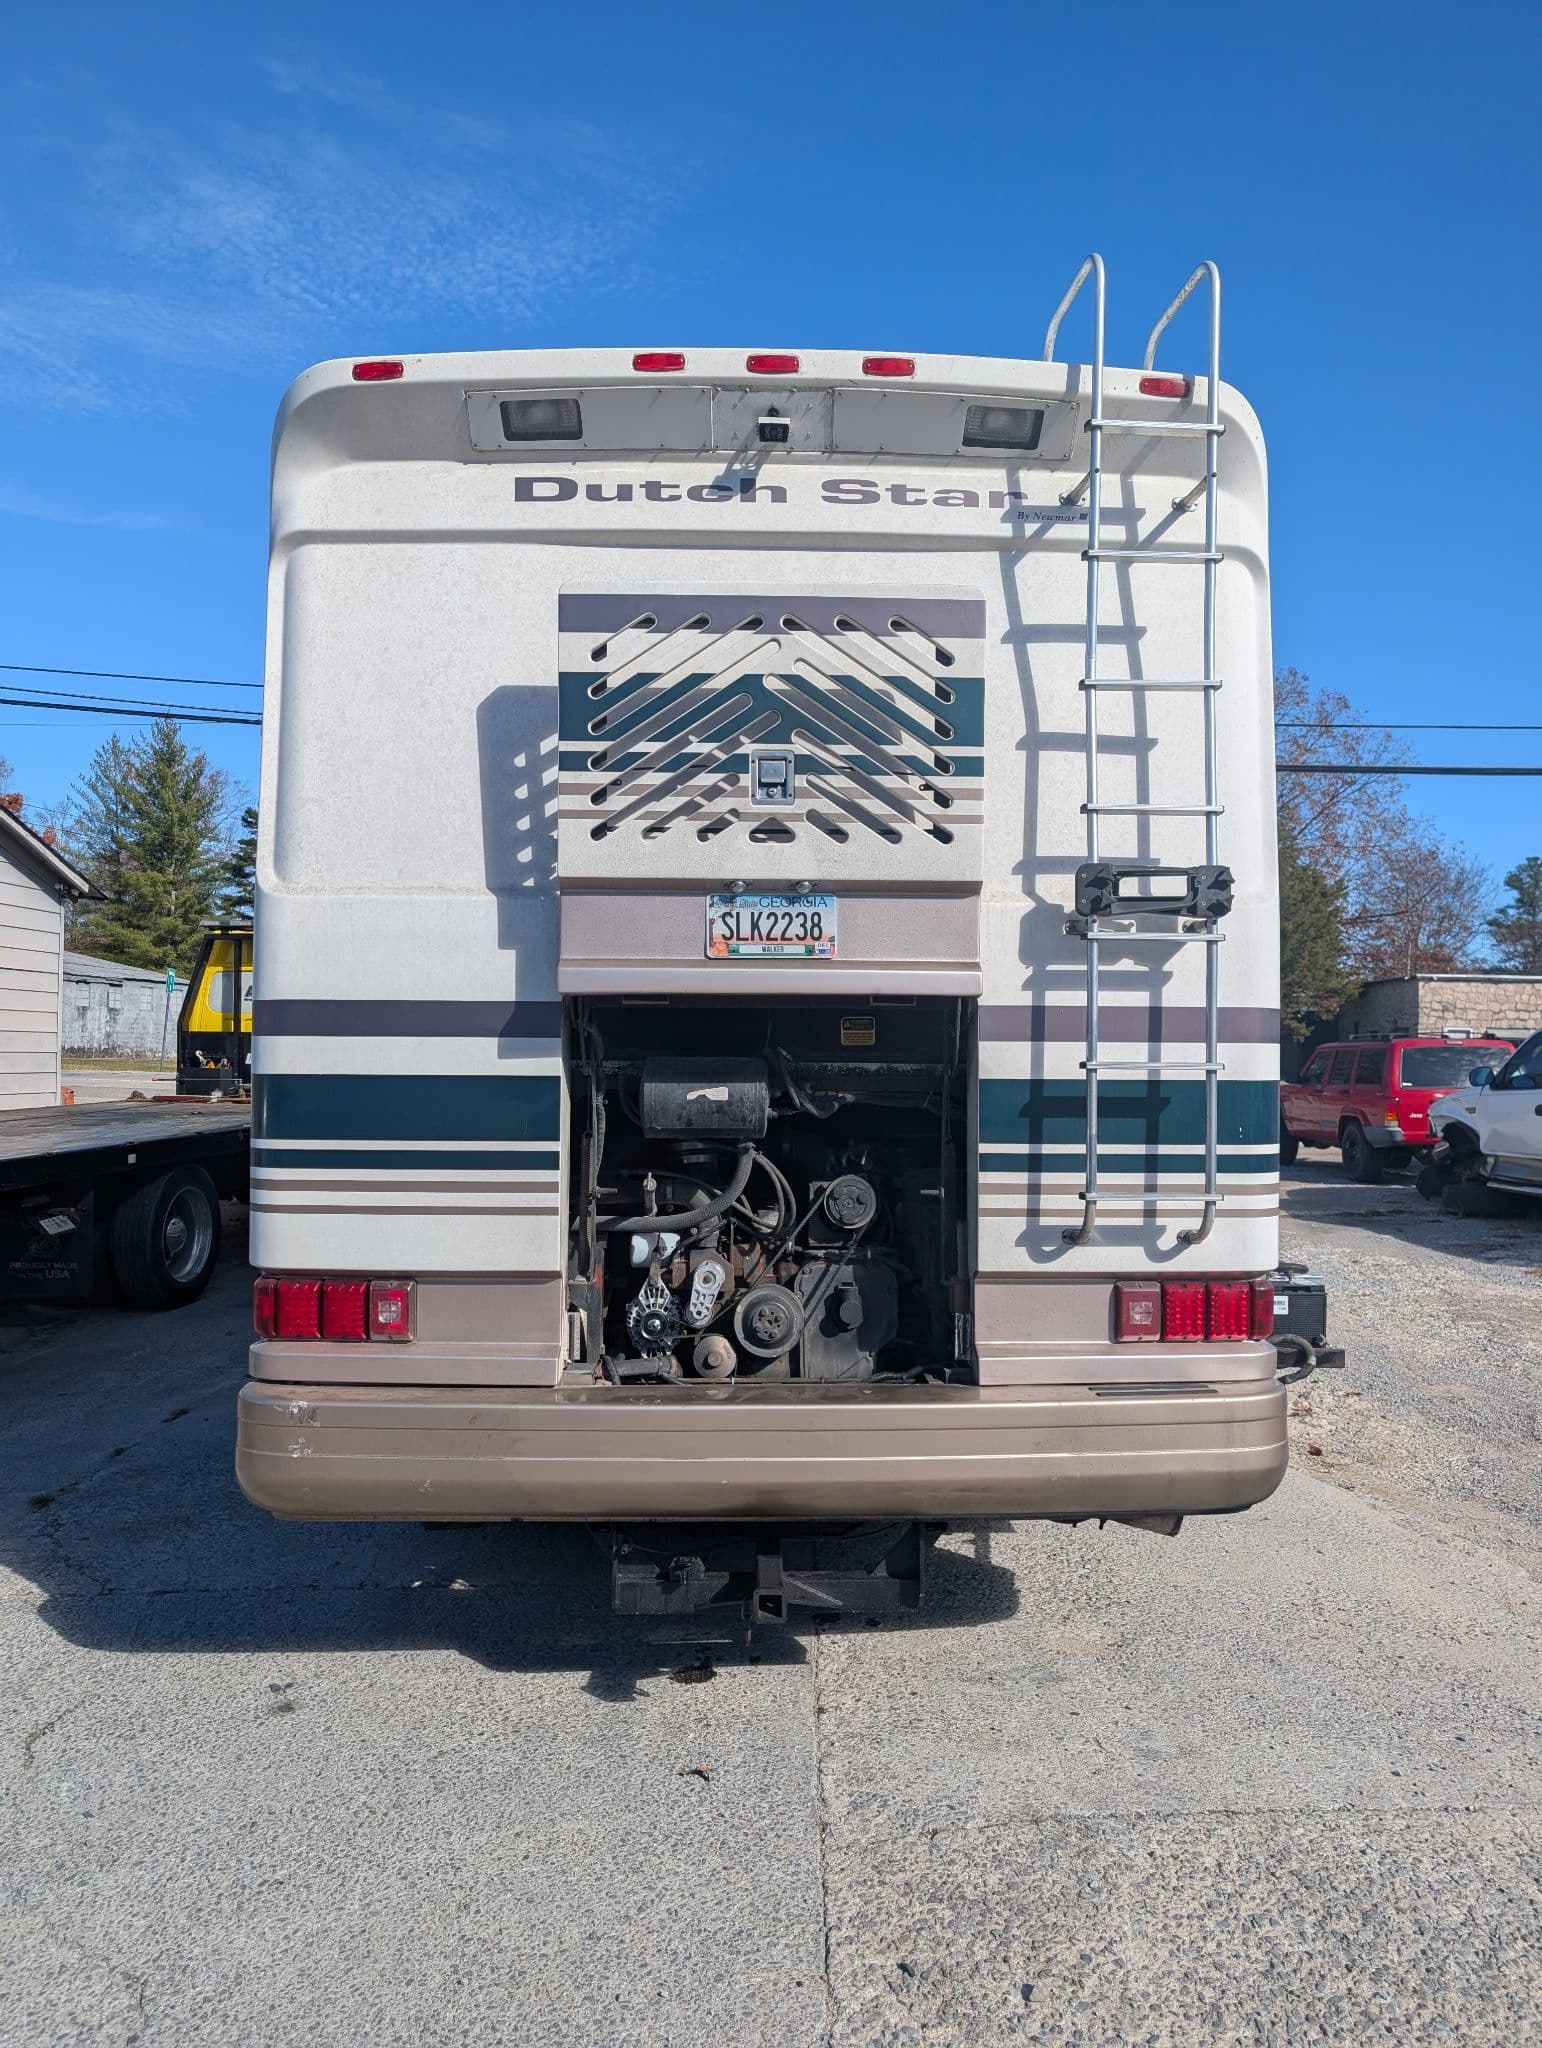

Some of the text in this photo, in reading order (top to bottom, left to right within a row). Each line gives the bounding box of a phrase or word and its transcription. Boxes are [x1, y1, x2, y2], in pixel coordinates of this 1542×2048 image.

[514, 476, 1030, 509] Dutch Star
[1017, 511, 1077, 522] By Newmar
[759, 896, 829, 908] GEORGIA
[721, 911, 823, 942] SLK2238
[46, 1270, 70, 1278] USA
